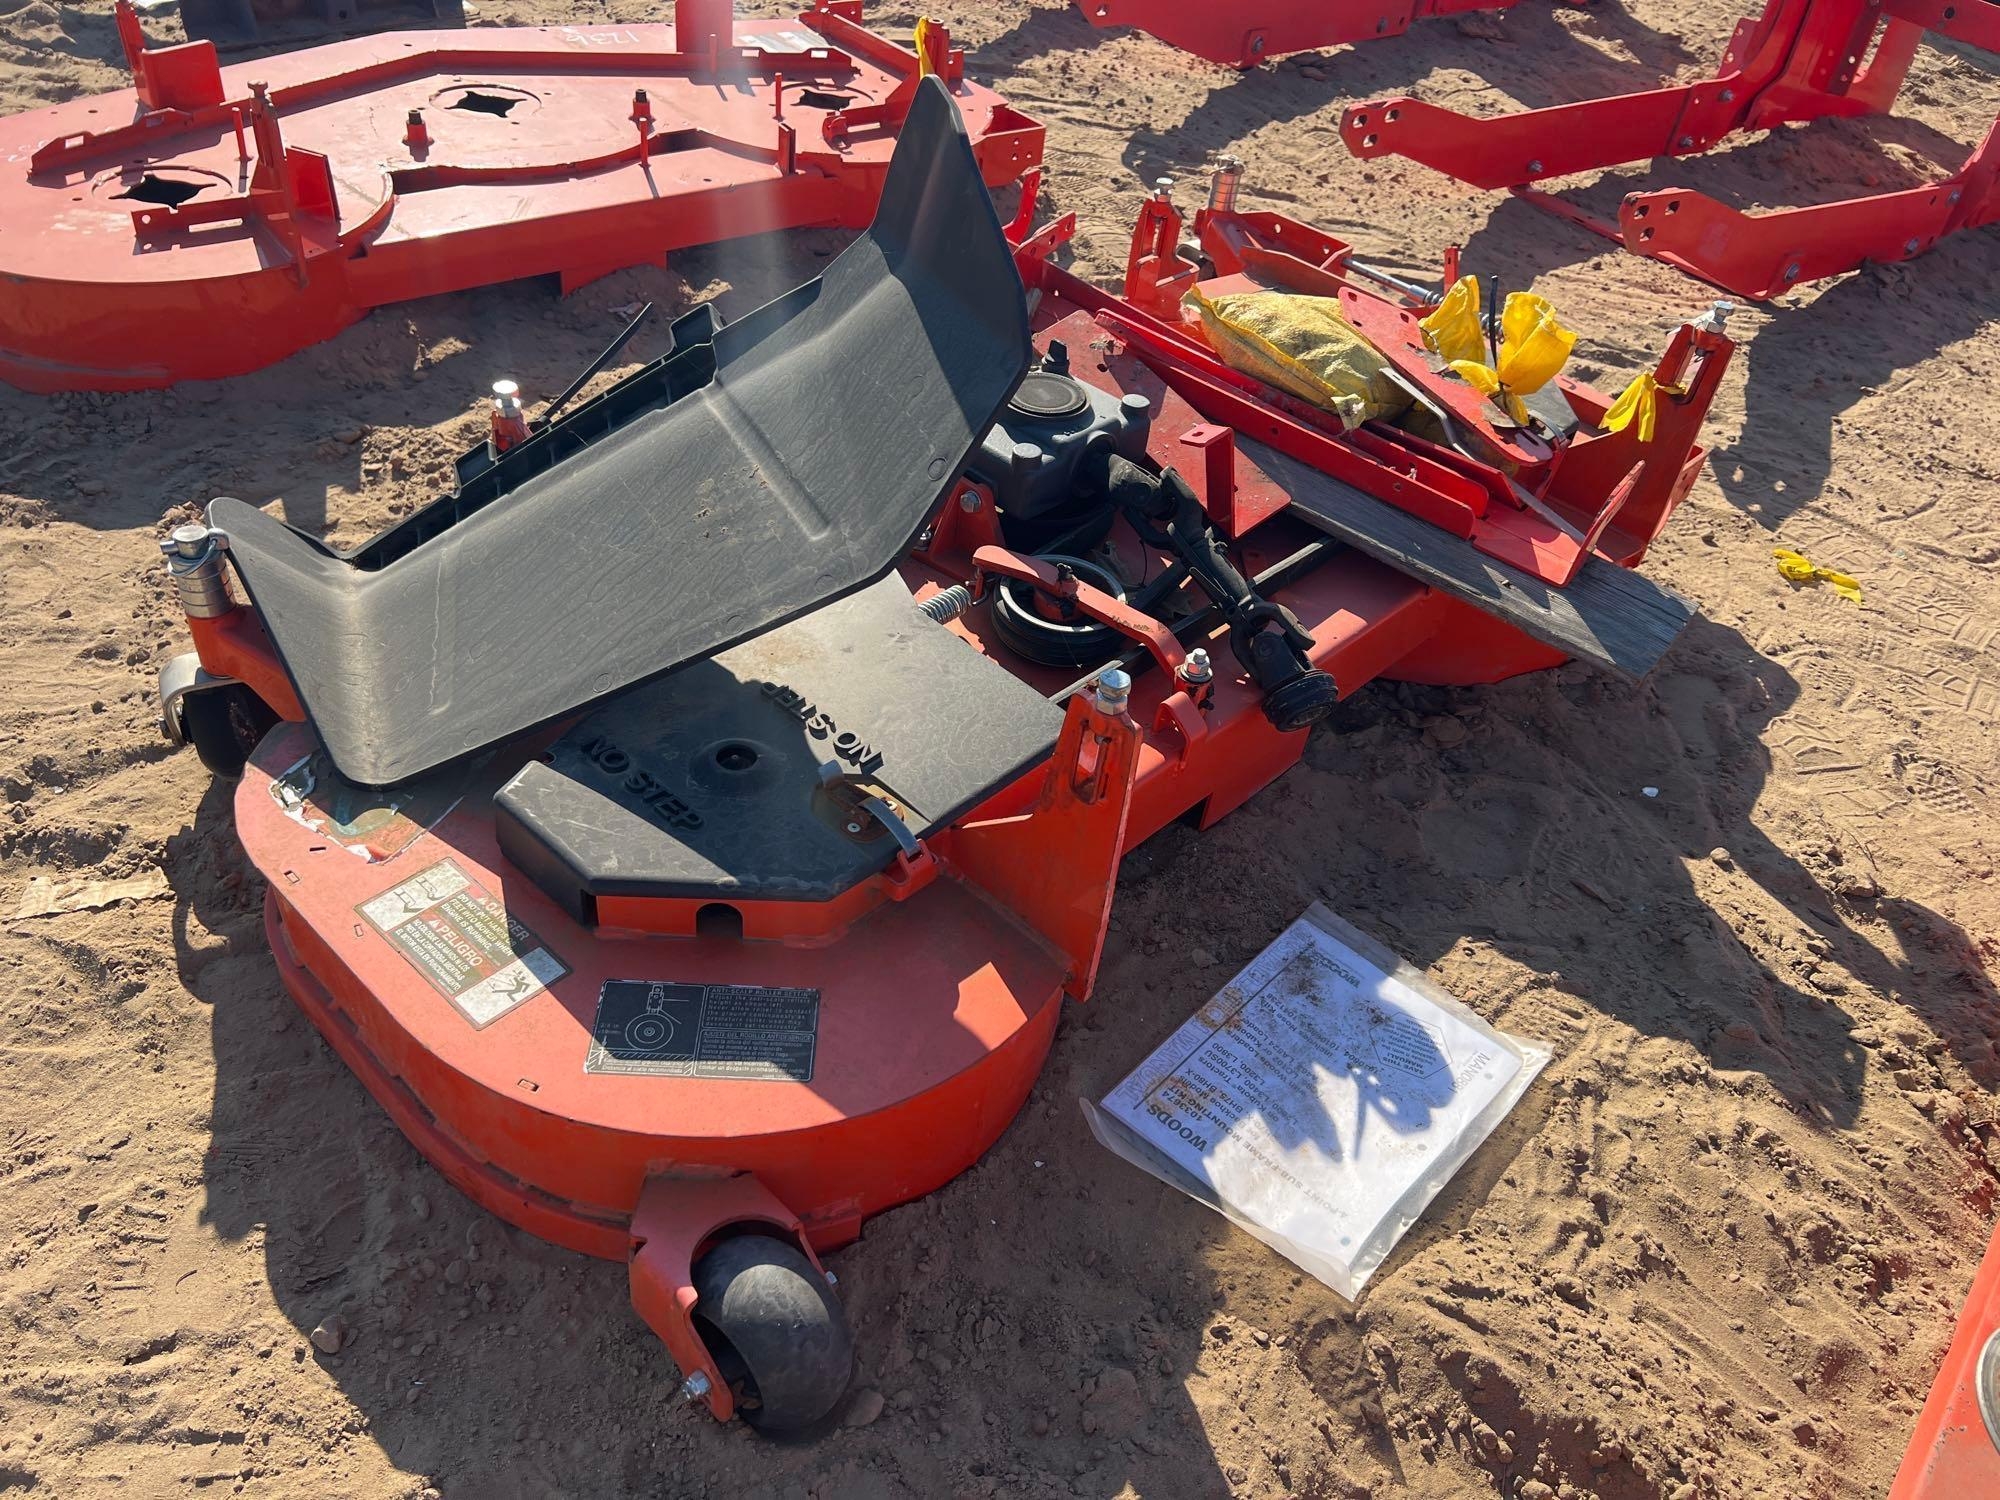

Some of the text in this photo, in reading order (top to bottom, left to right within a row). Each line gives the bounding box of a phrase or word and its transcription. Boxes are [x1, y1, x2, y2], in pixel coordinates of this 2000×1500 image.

[760, 682, 884, 774] NO STEP
[582, 735, 704, 829] NO STEP
[440, 902, 494, 950] ENGINE IS RUNNING.
[448, 897, 514, 957] FEET INTO MOWER WHEN
[456, 893, 517, 947] DO NOT PUT HANDS OR
[483, 901, 530, 941] DANGER
[435, 924, 484, 967] PELIGRO
[1113, 1030, 1201, 1106] MANUAL
[1195, 1055, 1233, 1083] Tractors
[1381, 1055, 1425, 1075] SAVE THIS
[1144, 1102, 1210, 1151] WOODS
[1160, 1090, 1204, 1121] 1033674
[1265, 1110, 1280, 1122] on
[1166, 1083, 1348, 1219] 4-POINT SUB-FRAME MOUNTING KIT
